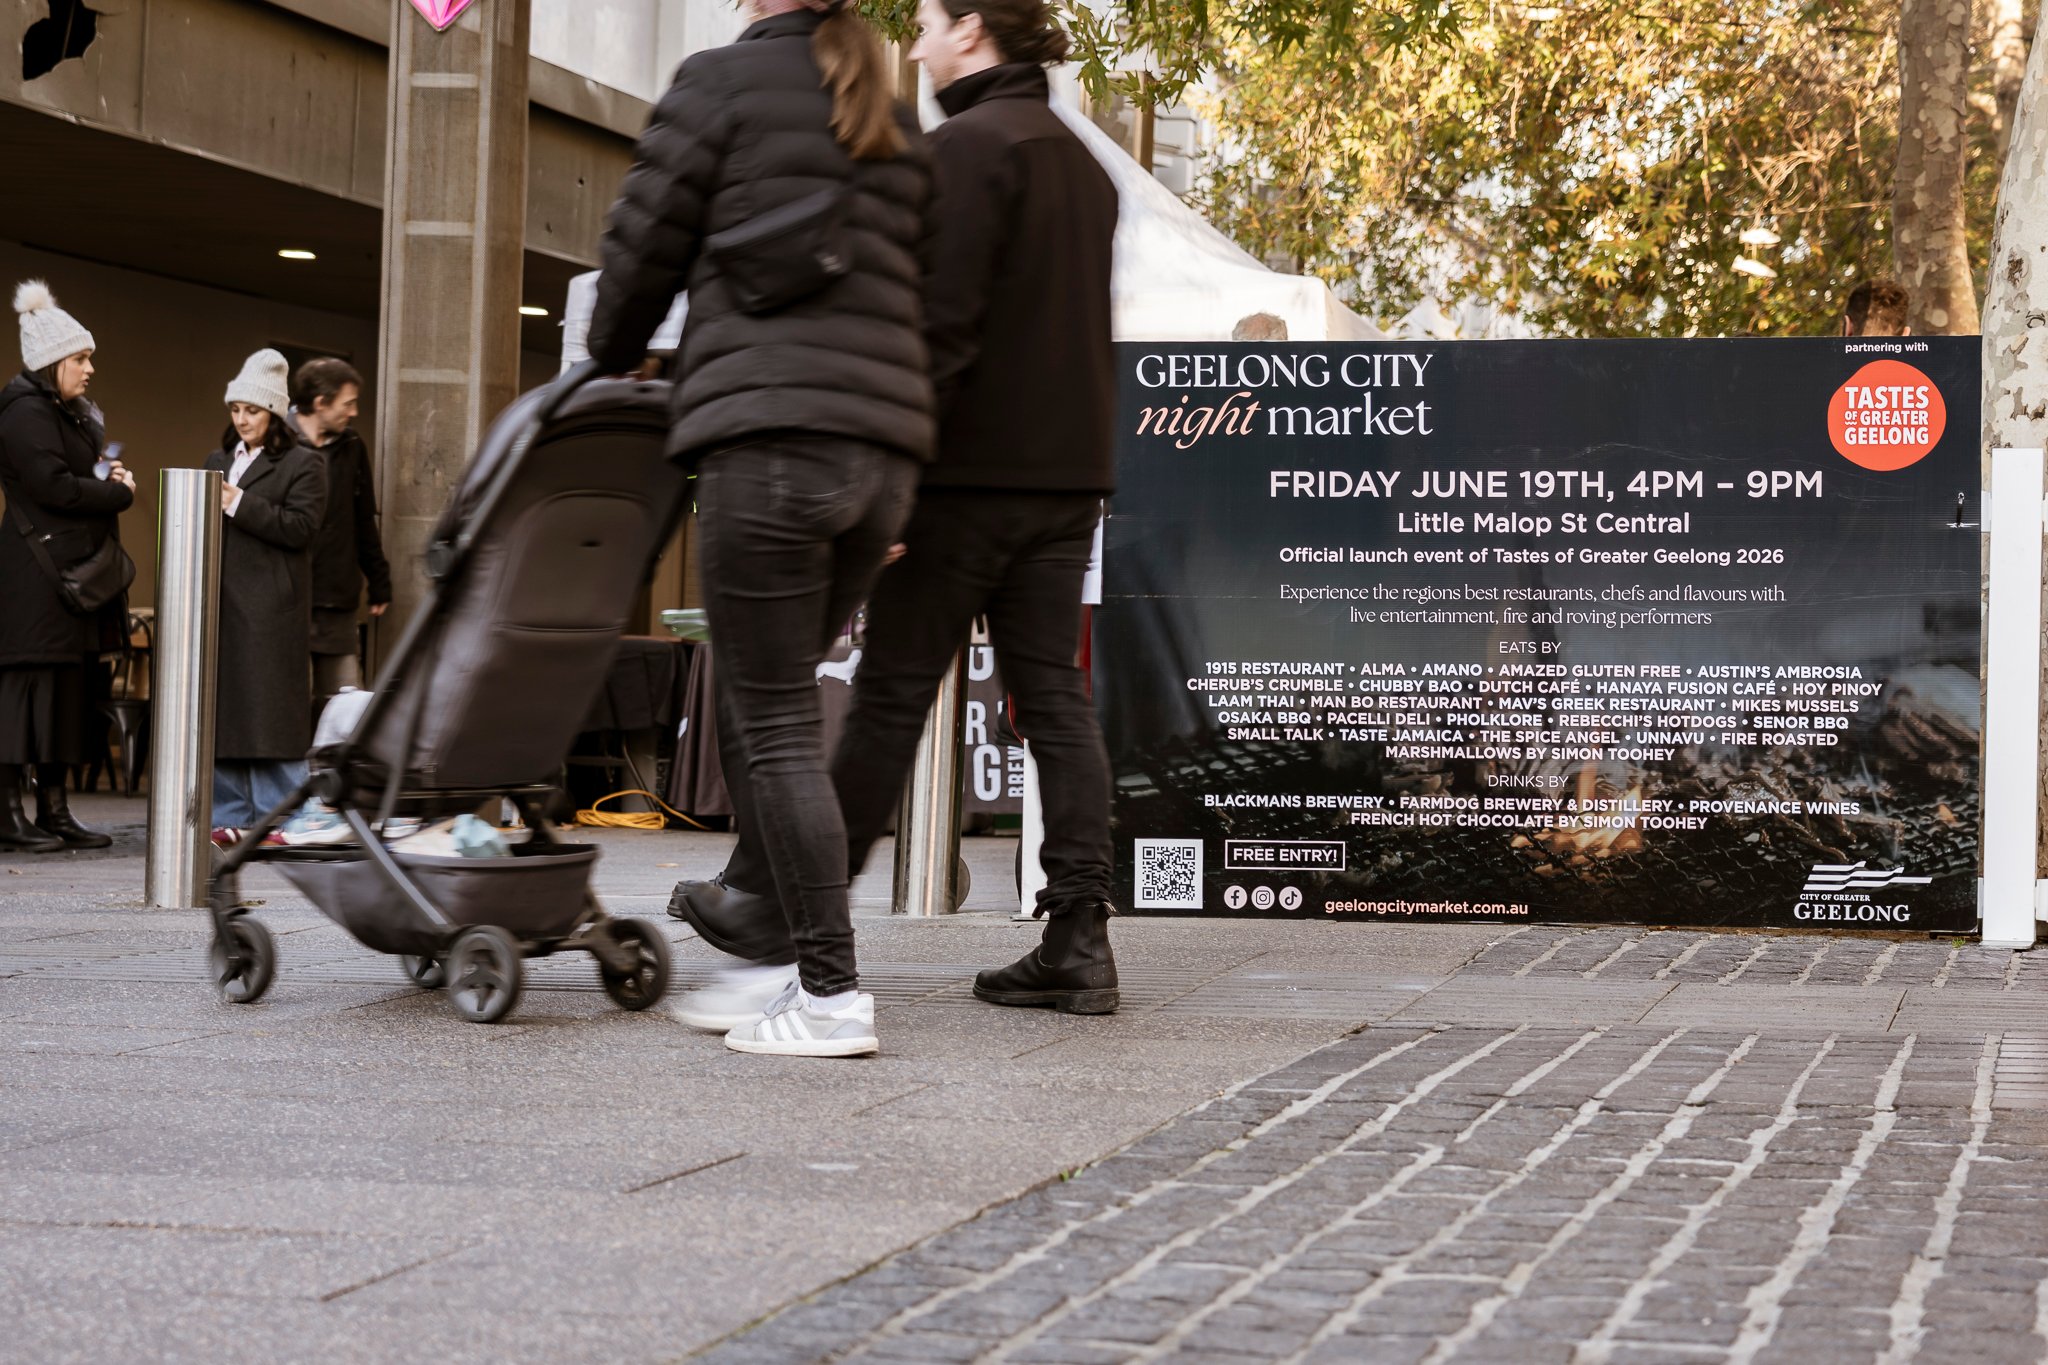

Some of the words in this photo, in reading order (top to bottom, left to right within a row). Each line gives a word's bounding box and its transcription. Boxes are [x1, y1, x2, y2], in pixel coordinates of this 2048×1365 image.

[1845, 343, 1901, 353] partnering
[1905, 342, 1928, 351] with
[1136, 355, 1330, 388] GEELONG
[1341, 355, 1433, 388] CITY
[1845, 386, 1929, 408] TASTES
[1136, 392, 1261, 449] night
[1268, 392, 1433, 435] market
[1845, 411, 1857, 420] OF
[1860, 411, 1928, 425] GREATER
[1845, 427, 1928, 444] GEELONG
[1270, 471, 1400, 498] FRIDAY
[1412, 471, 1507, 498] JUNE
[1519, 471, 1613, 502] 19TH,
[1627, 471, 1703, 498] 4PM
[1747, 471, 1822, 498] 9PM
[1398, 513, 1464, 532] Little
[1473, 513, 1551, 537] Malop
[1561, 513, 1587, 533] St
[1595, 513, 1689, 533] Central
[1279, 547, 1344, 563] Official
[1349, 547, 1408, 563] launch
[1414, 549, 1464, 563] event
[1469, 547, 1487, 563] of
[1493, 548, 1548, 563] Tastes
[1555, 547, 1573, 563] of
[1579, 548, 1647, 564] Greater
[1653, 547, 1731, 566] Geelong
[1736, 549, 1784, 564] 2026
[1280, 584, 1369, 604] Experience
[1373, 584, 1399, 600] the
[1403, 585, 1460, 605] regions
[1465, 584, 1499, 600] best
[1503, 585, 1597, 604] restaurants,
[1601, 584, 1644, 601] chefs
[1649, 584, 1680, 601] and
[1684, 584, 1746, 601] flavours
[1750, 585, 1785, 601] with
[1350, 606, 1376, 623] live
[1380, 607, 1498, 626] entertainment,
[1503, 607, 1527, 624] fire
[1531, 607, 1562, 624] and
[1567, 608, 1616, 627] roving
[1620, 607, 1712, 628] performers
[1500, 642, 1536, 653] EATS
[1542, 642, 1562, 653] BY
[1206, 662, 1236, 674] 1915
[1241, 663, 1344, 675] RESTAURANT
[1361, 664, 1405, 676] ALMA
[1422, 664, 1482, 676] AMANO
[1499, 665, 1567, 677] AMAZED
[1572, 665, 1635, 677] GLUTEN
[1641, 666, 1680, 678] FREE
[1698, 666, 1770, 678] AUSTIN'S
[1775, 666, 1862, 679] AMBROSIA
[1187, 679, 1264, 691] CHERUB'S
[1269, 679, 1343, 691] CRUMBLE
[1359, 680, 1425, 692] CHUBBY
[1429, 680, 1462, 693] BAO
[1479, 681, 1532, 693] DUTCH
[1537, 678, 1580, 693] CAFÉ
[1597, 682, 1663, 694] HANAYA
[1668, 682, 1728, 694] FUSION
[1733, 680, 1776, 695] CAFÉ
[1793, 683, 1827, 696] HOY
[1832, 683, 1882, 696] PINOY
[1209, 695, 1252, 707] LAAM
[1258, 696, 1293, 707] THAI
[1311, 696, 1345, 708] MAN
[1351, 696, 1374, 708] BO
[1379, 696, 1482, 709] RESTAURANT
[1499, 697, 1546, 710] MAV'S
[1551, 698, 1605, 710] GREEK
[1610, 699, 1715, 711] RESTAURANT
[1732, 700, 1780, 712] MIKES
[1785, 700, 1859, 712] MUSSELS
[1218, 711, 1272, 724] OSAKA
[1278, 712, 1311, 724] BBQ
[1328, 712, 1390, 725] PACELLI
[1396, 713, 1430, 725] DELI
[1447, 713, 1542, 726] PHOLKLORE
[1560, 715, 1652, 727] REBECCHI'S
[1657, 715, 1737, 728] HOTDOGS
[1753, 716, 1809, 728] SENOR
[1814, 717, 1848, 730] BBQ
[1228, 728, 1279, 740] SMALL
[1284, 728, 1323, 740] TALK
[1340, 729, 1387, 741] TASTE
[1392, 730, 1463, 742] JAMAICA
[1481, 730, 1511, 742] THE
[1516, 730, 1560, 743] SPICE
[1565, 731, 1620, 743] ANGEL
[1637, 732, 1704, 744] UNNAVU
[1722, 733, 1757, 745] FIRE
[1762, 733, 1838, 746] ROASTED
[1386, 746, 1522, 759] MARSHMALLOWS
[1526, 748, 1547, 759] BY
[1552, 748, 1603, 760] SIMON
[1608, 748, 1675, 761] TOOHEY
[1488, 775, 1544, 787] DRINKS
[1549, 776, 1568, 788] BY
[1205, 794, 1301, 807] BLACKMANS
[1306, 796, 1384, 809] BREWERY
[1400, 797, 1479, 810] FARMDOG
[1484, 798, 1562, 811] BREWERY
[1567, 799, 1578, 811] &
[1582, 799, 1673, 812] DISTILLERY
[1689, 801, 1801, 814] PROVENANCE
[1805, 802, 1860, 815] WINES
[1351, 813, 1414, 825] FRENCH
[1419, 813, 1452, 826] HOT
[1456, 814, 1553, 828] CHOCOLATE
[1558, 816, 1580, 828] BY
[1584, 816, 1636, 829] SIMON
[1641, 817, 1708, 830] TOOHEY
[1233, 848, 1274, 861] FREE
[1279, 849, 1337, 862] ENTRY!
[1325, 899, 1528, 915] geelongcitymarket.com.au
[1794, 903, 1910, 921] GEELONG
